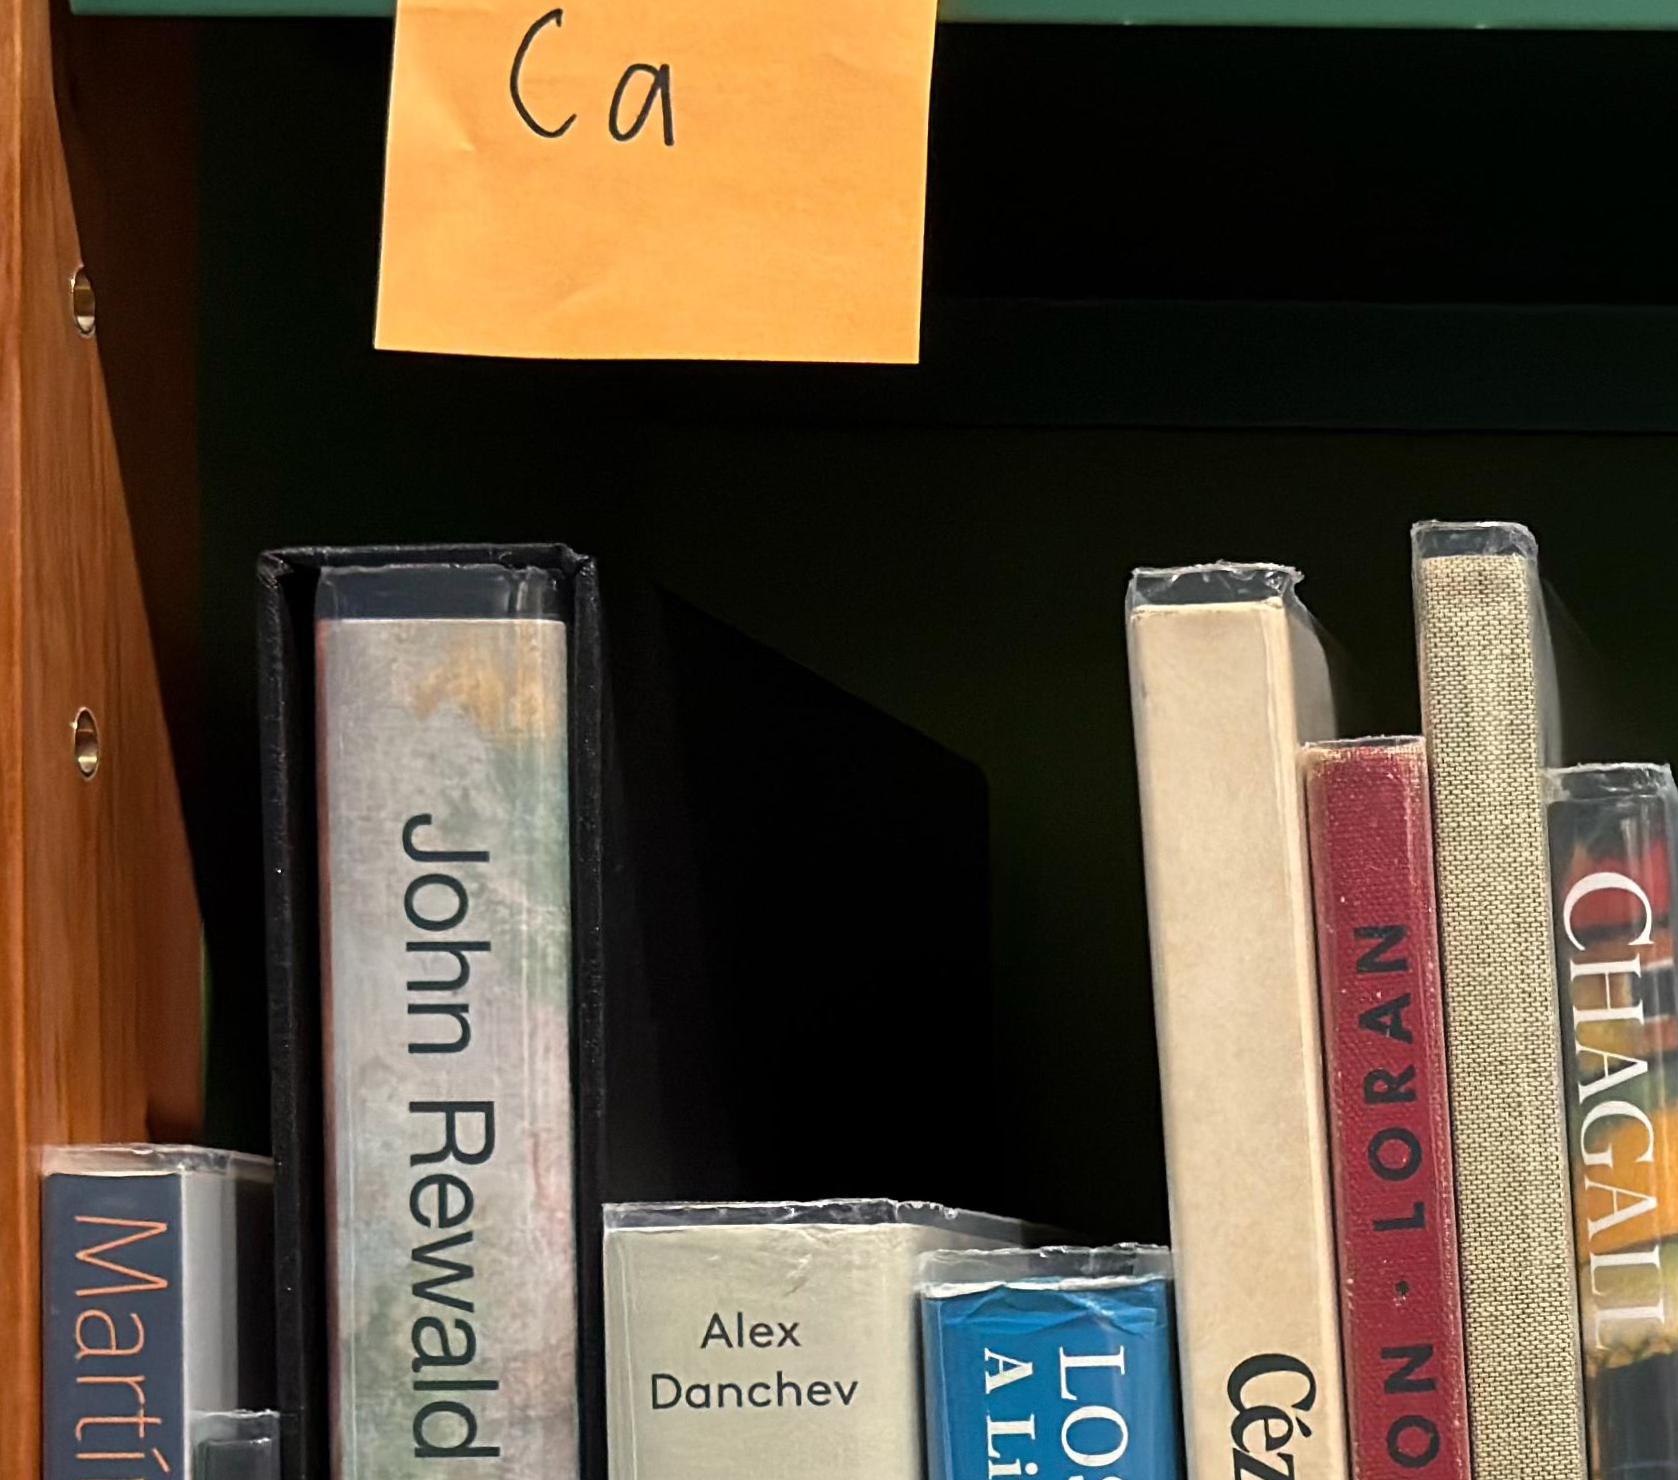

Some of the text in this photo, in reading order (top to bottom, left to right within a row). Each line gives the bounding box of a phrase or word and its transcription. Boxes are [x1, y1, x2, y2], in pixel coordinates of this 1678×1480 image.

[510, 8, 676, 146] Ca
[400, 813, 491, 1054] John
[1353, 923, 1428, 1235] LORAN
[1562, 869, 1667, 1352] CHAGALL
[407, 1100, 501, 1460] Rewald
[700, 1310, 803, 1350] Alex
[983, 1347, 1034, 1396] A
[650, 1370, 861, 1410] Danchev
